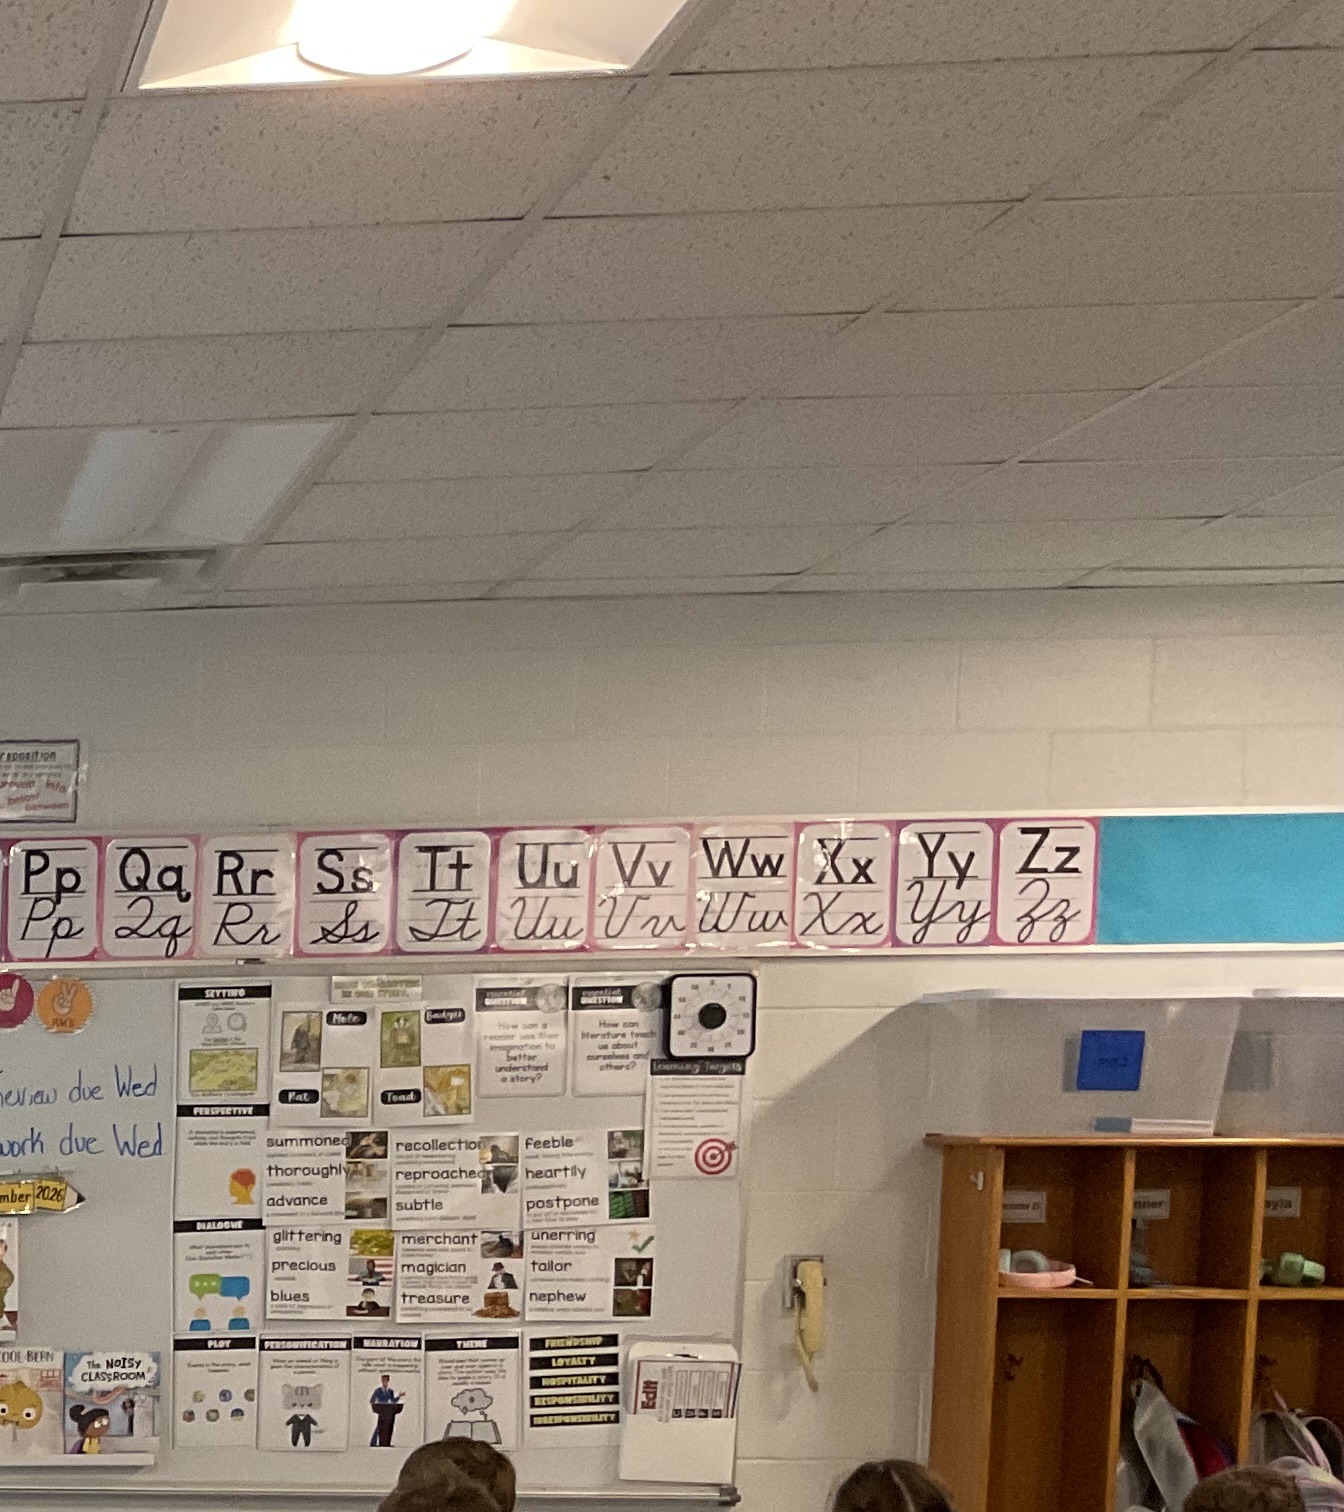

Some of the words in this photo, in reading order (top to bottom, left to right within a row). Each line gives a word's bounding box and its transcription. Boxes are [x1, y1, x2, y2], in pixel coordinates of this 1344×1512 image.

[24, 850, 81, 905] Pp
[119, 848, 192, 903] Qq
[217, 850, 274, 895] Rr
[317, 850, 375, 894] Ss
[416, 847, 473, 891] Tt
[519, 843, 578, 888] Uu
[612, 842, 672, 887] Vv
[703, 838, 786, 878] Ww
[815, 838, 876, 883] Xx
[917, 833, 977, 889] Yy
[1019, 828, 1081, 874] Zz
[69, 1069, 105, 1103] due
[114, 1063, 158, 1098] Wed
[193, 1106, 254, 1116] PERSPECTIVE
[59, 1122, 105, 1156] due
[113, 1122, 163, 1158] Wed
[266, 1135, 352, 1148] summoned
[395, 1139, 486, 1152] recollection
[525, 1136, 574, 1149] feeble
[267, 1164, 348, 1178] thoroughly
[395, 1167, 489, 1183] reproached
[525, 1165, 587, 1179] heartily
[36, 1186, 63, 1201] 2026
[266, 1195, 328, 1207] advance
[395, 1199, 444, 1211] subtle
[526, 1196, 600, 1213] postpone
[196, 1221, 244, 1231] DIALOGUE
[273, 1229, 342, 1245] glittering
[401, 1232, 479, 1245] merchant
[531, 1230, 596, 1243] unerring
[271, 1259, 336, 1273] precious
[401, 1262, 466, 1276] magician
[531, 1260, 572, 1272] tailor
[270, 1289, 310, 1302] blues
[400, 1291, 470, 1304] treasure
[529, 1290, 587, 1305] nephew
[207, 1339, 231, 1348] PLOT
[27, 1350, 54, 1363] BEAN
[551, 1356, 596, 1367] LOYALTY
[87, 1360, 100, 1369] The
[106, 1357, 142, 1370] NOISY
[81, 1371, 146, 1383] CLASSROOM
[542, 1375, 606, 1386] HOSPITALITY
